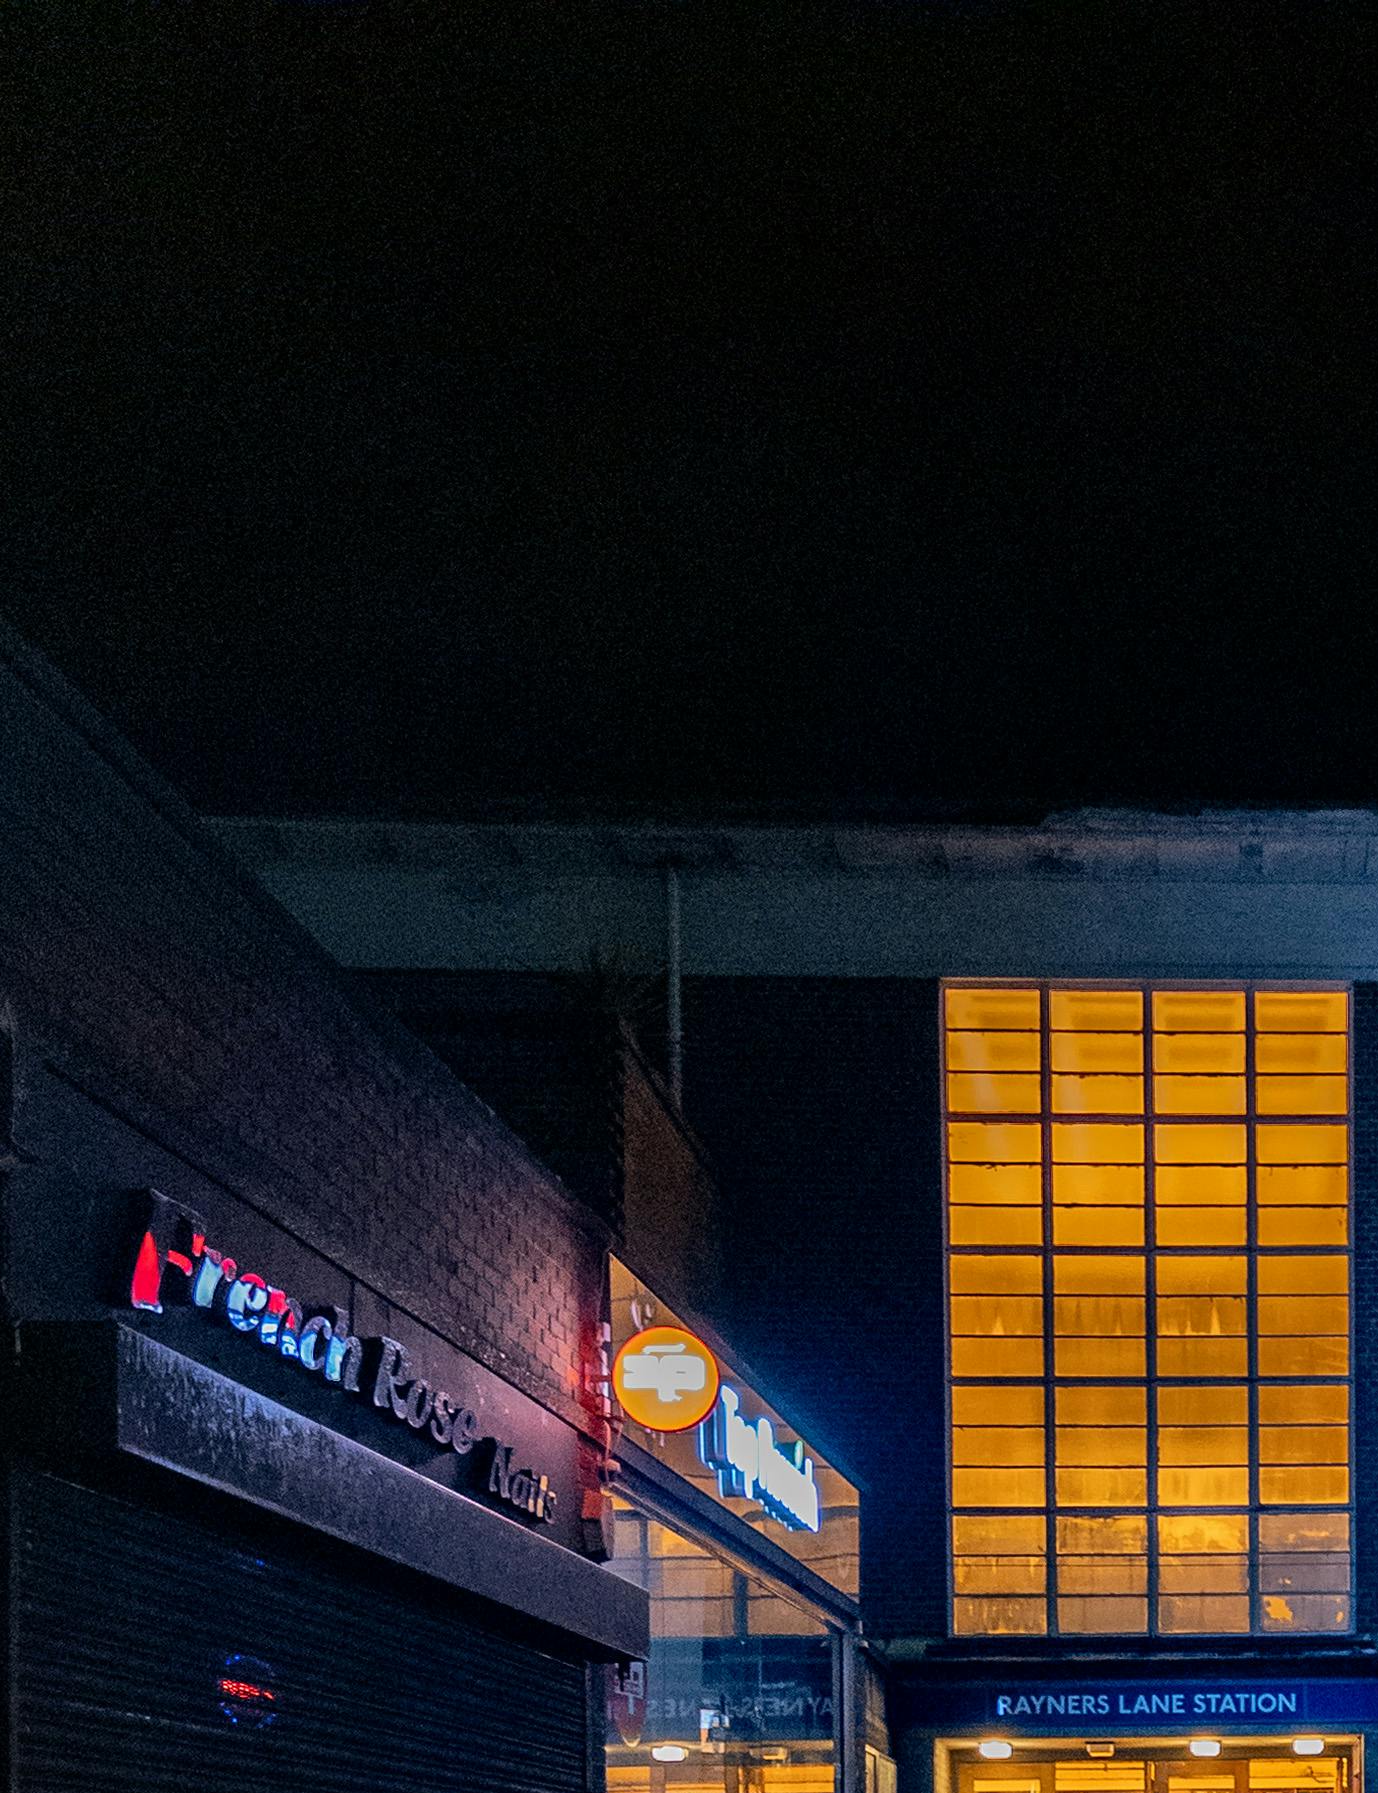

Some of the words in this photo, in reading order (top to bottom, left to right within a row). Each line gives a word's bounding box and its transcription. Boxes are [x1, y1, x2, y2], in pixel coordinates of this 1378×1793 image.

[130, 1187, 361, 1392] French
[373, 1336, 484, 1455] Rose
[996, 1694, 1110, 1716] RAYNERS
[1118, 1694, 1186, 1714] LANE
[1193, 1693, 1297, 1713] STATION
